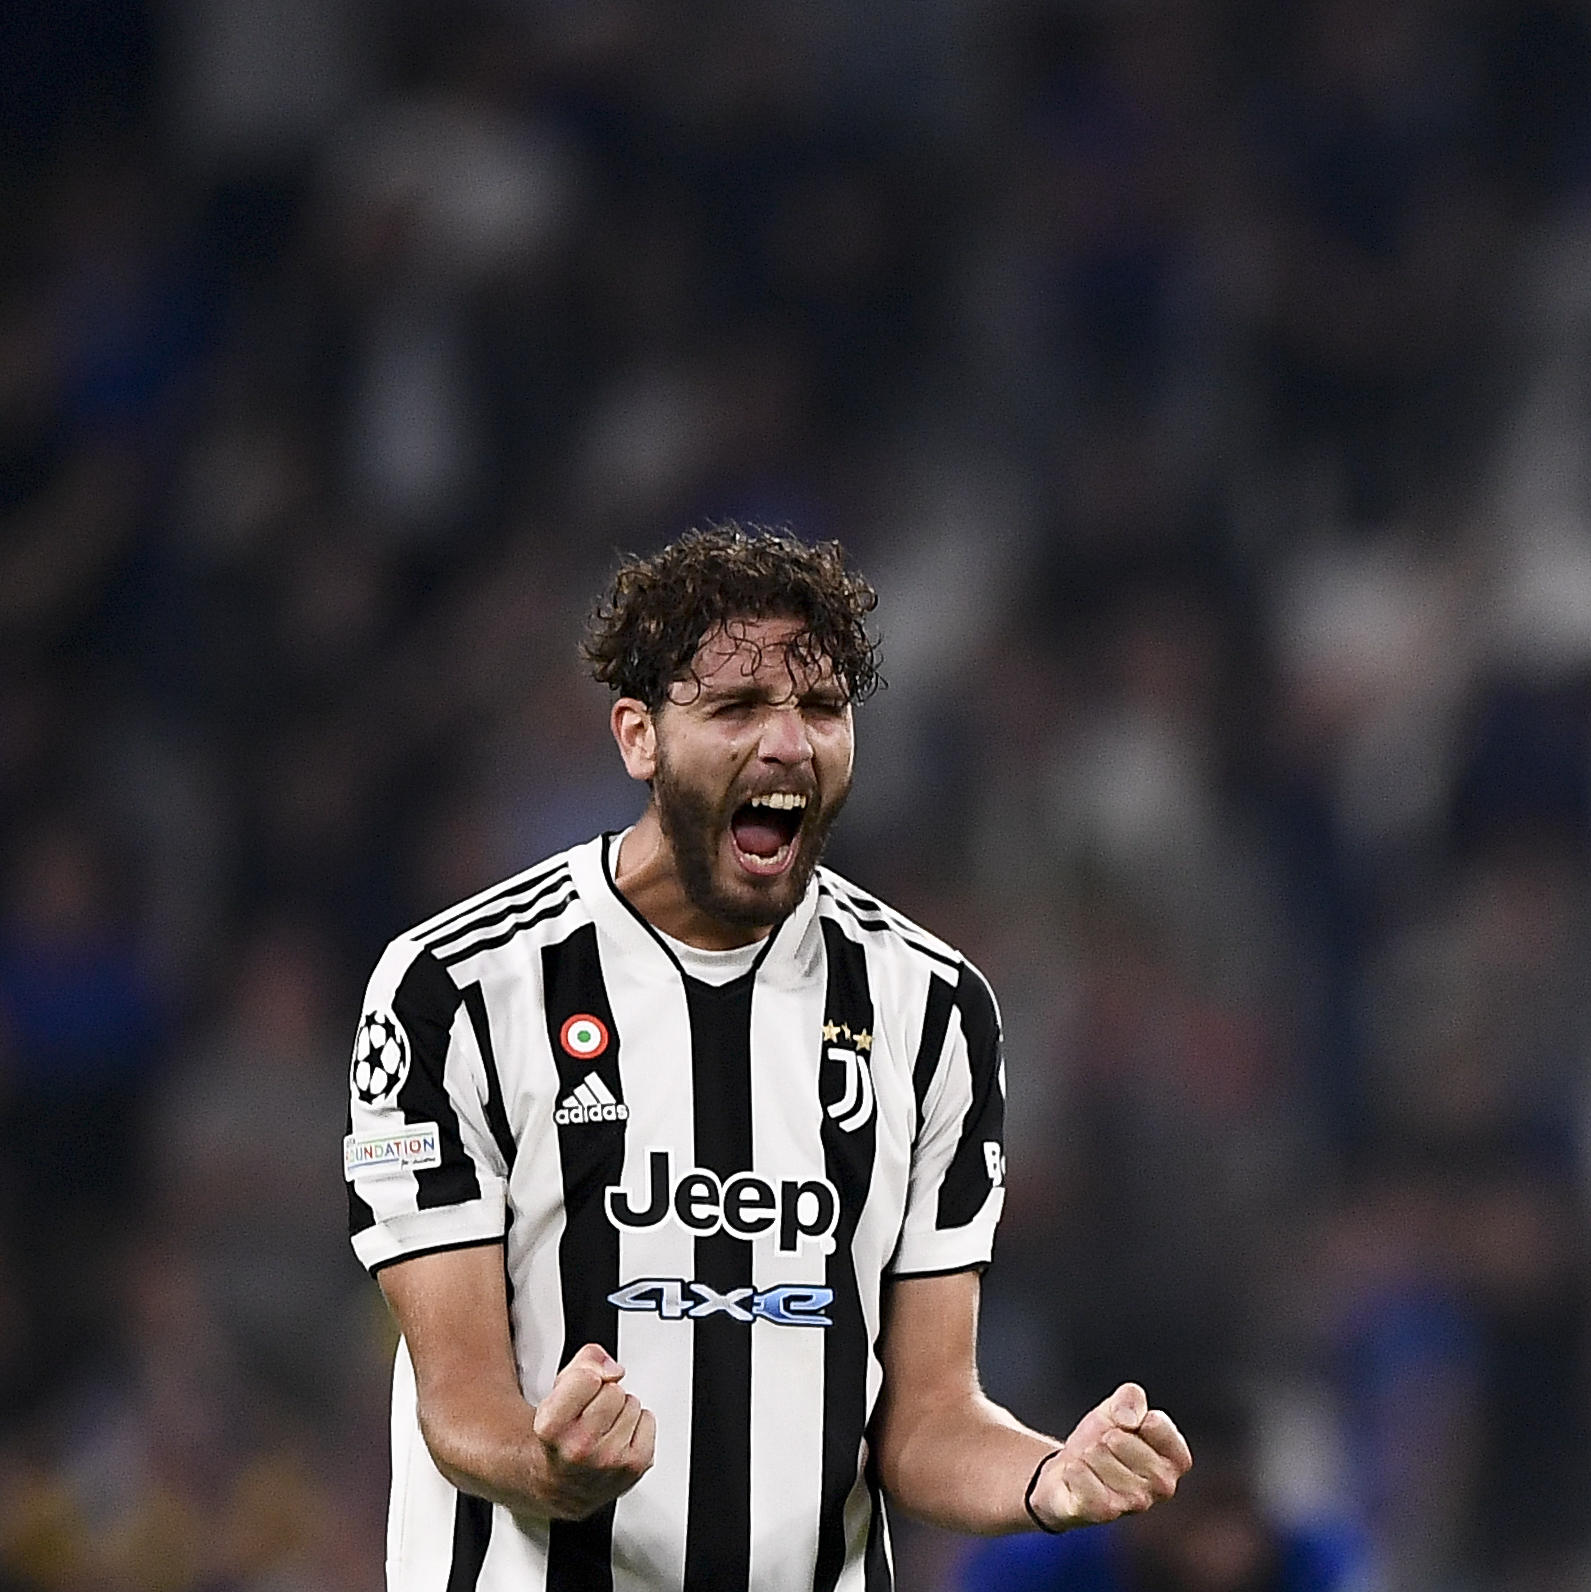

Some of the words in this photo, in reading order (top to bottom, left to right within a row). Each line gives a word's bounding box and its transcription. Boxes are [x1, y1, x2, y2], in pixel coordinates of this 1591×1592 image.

[555, 1103, 629, 1124] adidas
[346, 1136, 435, 1165] OUNDATION
[607, 1152, 838, 1254] Jeep
